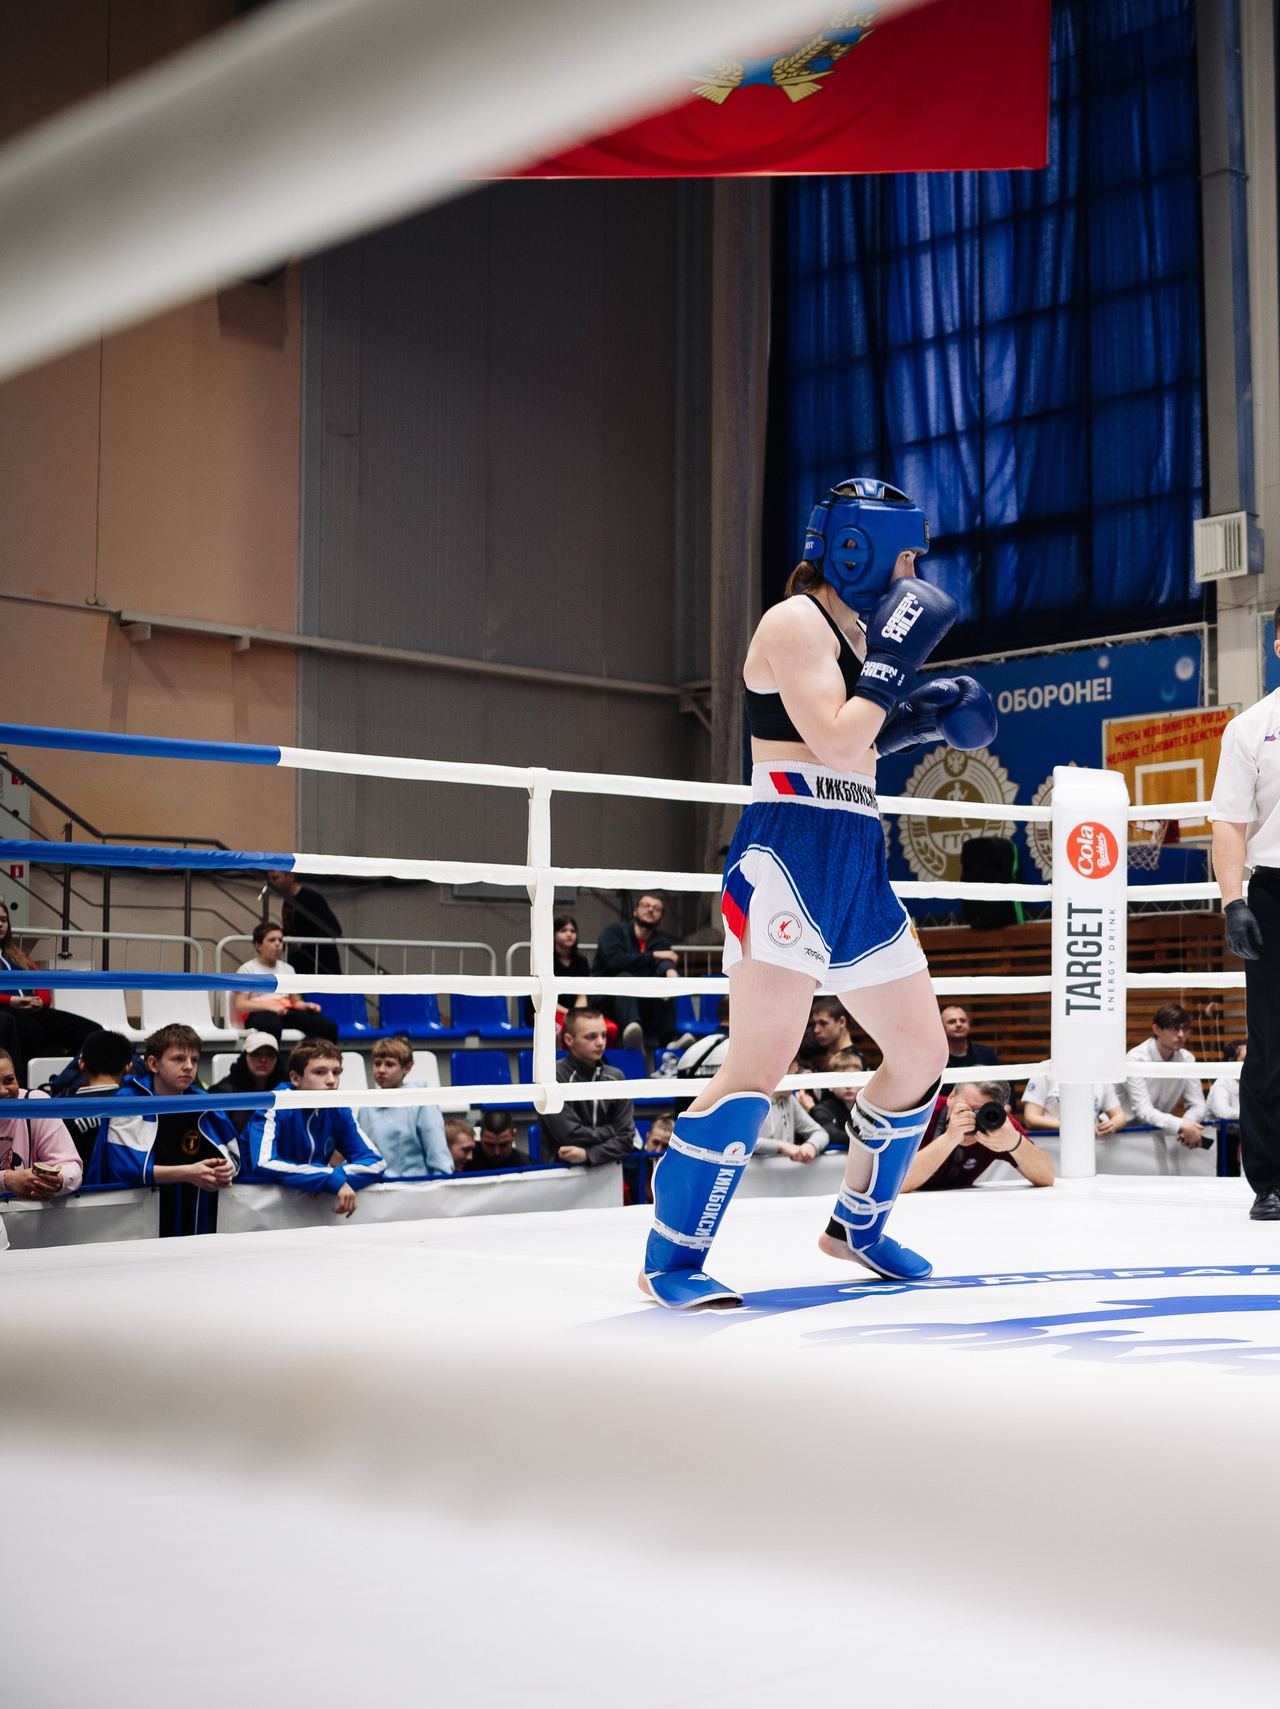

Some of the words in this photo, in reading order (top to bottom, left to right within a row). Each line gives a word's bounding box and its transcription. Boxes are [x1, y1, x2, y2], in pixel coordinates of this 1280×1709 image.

[881, 591, 917, 639] GREEN
[890, 604, 924, 643] HILL
[860, 667, 889, 682] HILL
[863, 660, 898, 677] GREEN
[997, 676, 1112, 714] ОБОРОНЕ!
[1105, 748, 1140, 765] ЖЕЛАНИЕ
[1141, 735, 1188, 757] СТАНОВИТСЯ
[1190, 725, 1226, 746] ДЕЙСТВИ
[1114, 730, 1140, 745] МЕЧТЫ
[1201, 710, 1226, 724] КОГДА
[816, 775, 877, 808] КИКБОКСИ
[1076, 825, 1094, 876] Cola
[1108, 908, 1116, 951] DRINK
[1065, 902, 1103, 1016] TARGET
[1107, 960, 1115, 1012] ENERGY
[689, 1167, 736, 1252] КИКБОКСИГ
